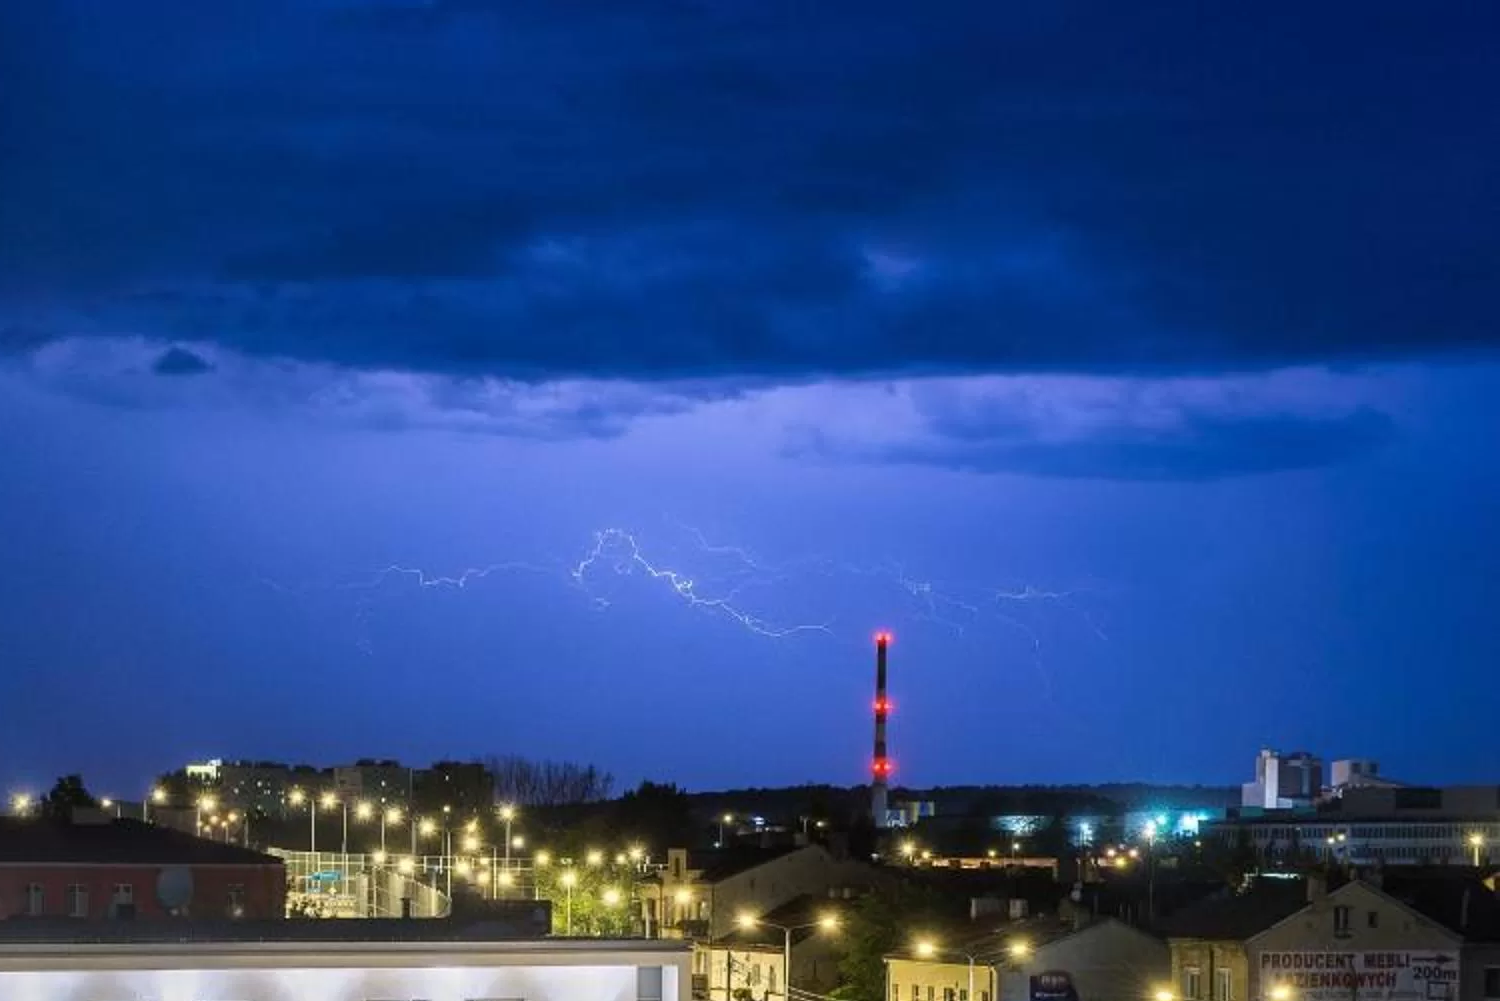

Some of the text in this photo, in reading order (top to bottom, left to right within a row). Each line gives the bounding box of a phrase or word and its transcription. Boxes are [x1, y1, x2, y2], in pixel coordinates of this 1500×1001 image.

[1262, 953, 1410, 969] PRODUCENT MEBLI
[1414, 966, 1457, 980] 200m
